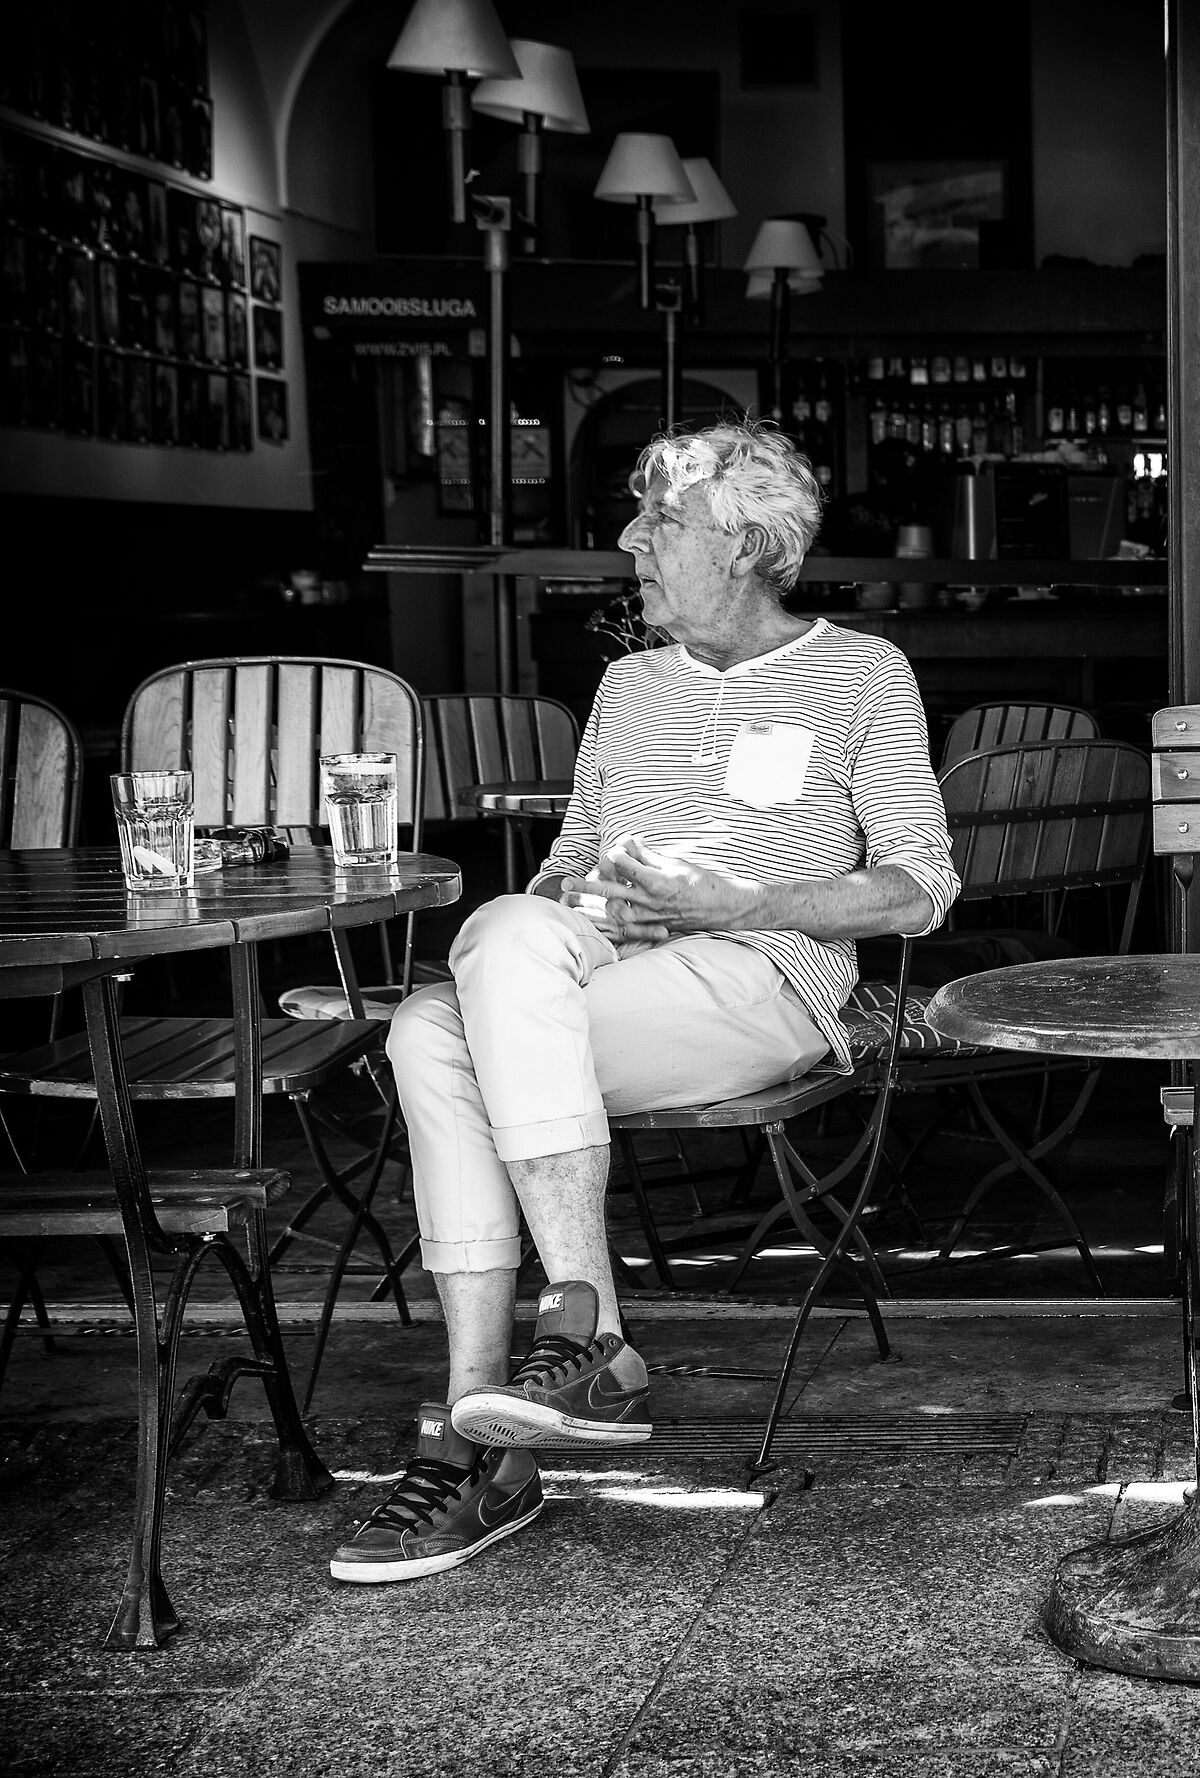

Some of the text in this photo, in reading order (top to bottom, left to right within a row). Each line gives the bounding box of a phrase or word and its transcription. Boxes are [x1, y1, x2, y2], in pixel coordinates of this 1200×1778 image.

[323, 295, 478, 318] SAMOOBSŁUGA
[539, 1292, 564, 1313] NIKE
[420, 1419, 444, 1438] NIKE
